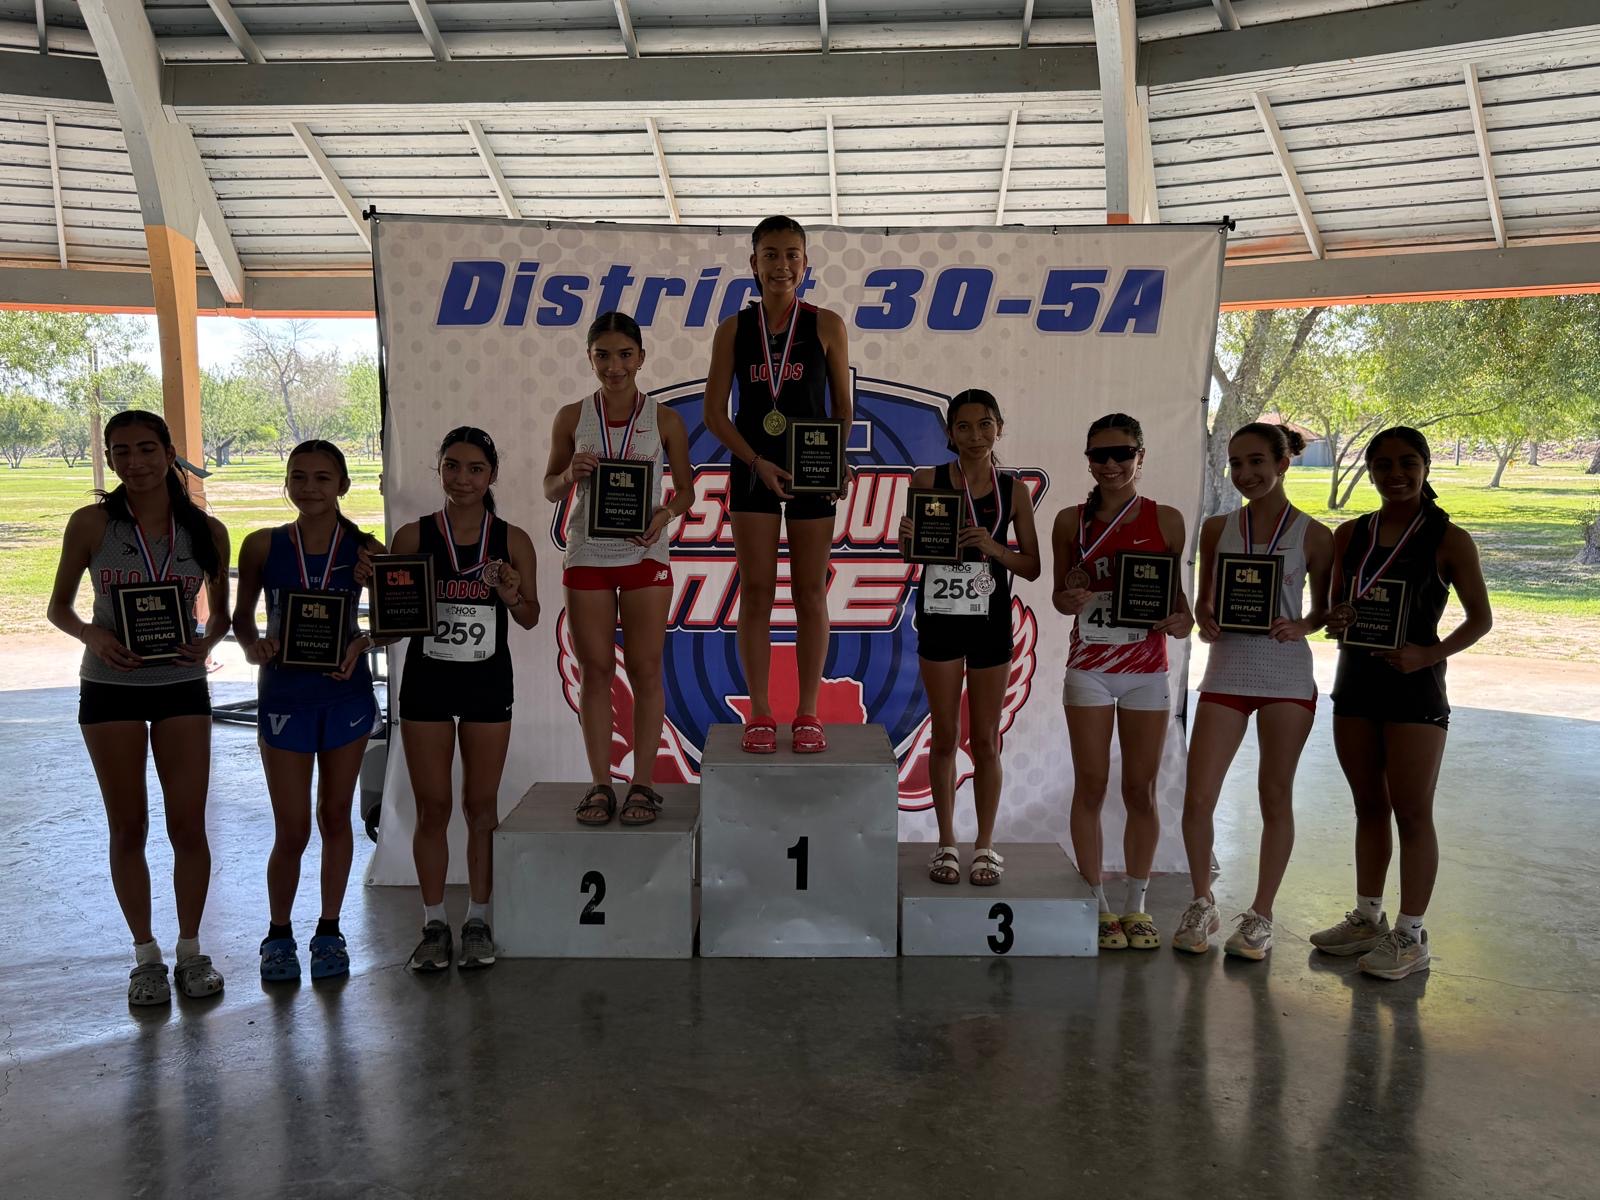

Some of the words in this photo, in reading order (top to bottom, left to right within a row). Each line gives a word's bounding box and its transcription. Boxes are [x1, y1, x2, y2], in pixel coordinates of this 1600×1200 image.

[854, 267, 1167, 334] 30-5A
[804, 429, 828, 445] UIL
[609, 470, 635, 488] UIL
[618, 508, 637, 516] PLACE
[925, 501, 948, 517] UIL
[1134, 563, 1159, 580] UIL
[1236, 568, 1261, 584] UIL
[436, 580, 490, 600] LOBOS
[932, 578, 980, 600] 258
[302, 602, 329, 619] UIL
[434, 621, 486, 646] 259
[1369, 623, 1388, 631] PLACE
[154, 632, 176, 641] PLACE
[309, 641, 329, 649] PLACE
[268, 713, 291, 735] V
[787, 836, 808, 890] 1
[579, 870, 606, 925] 2
[986, 902, 1014, 954] 3
